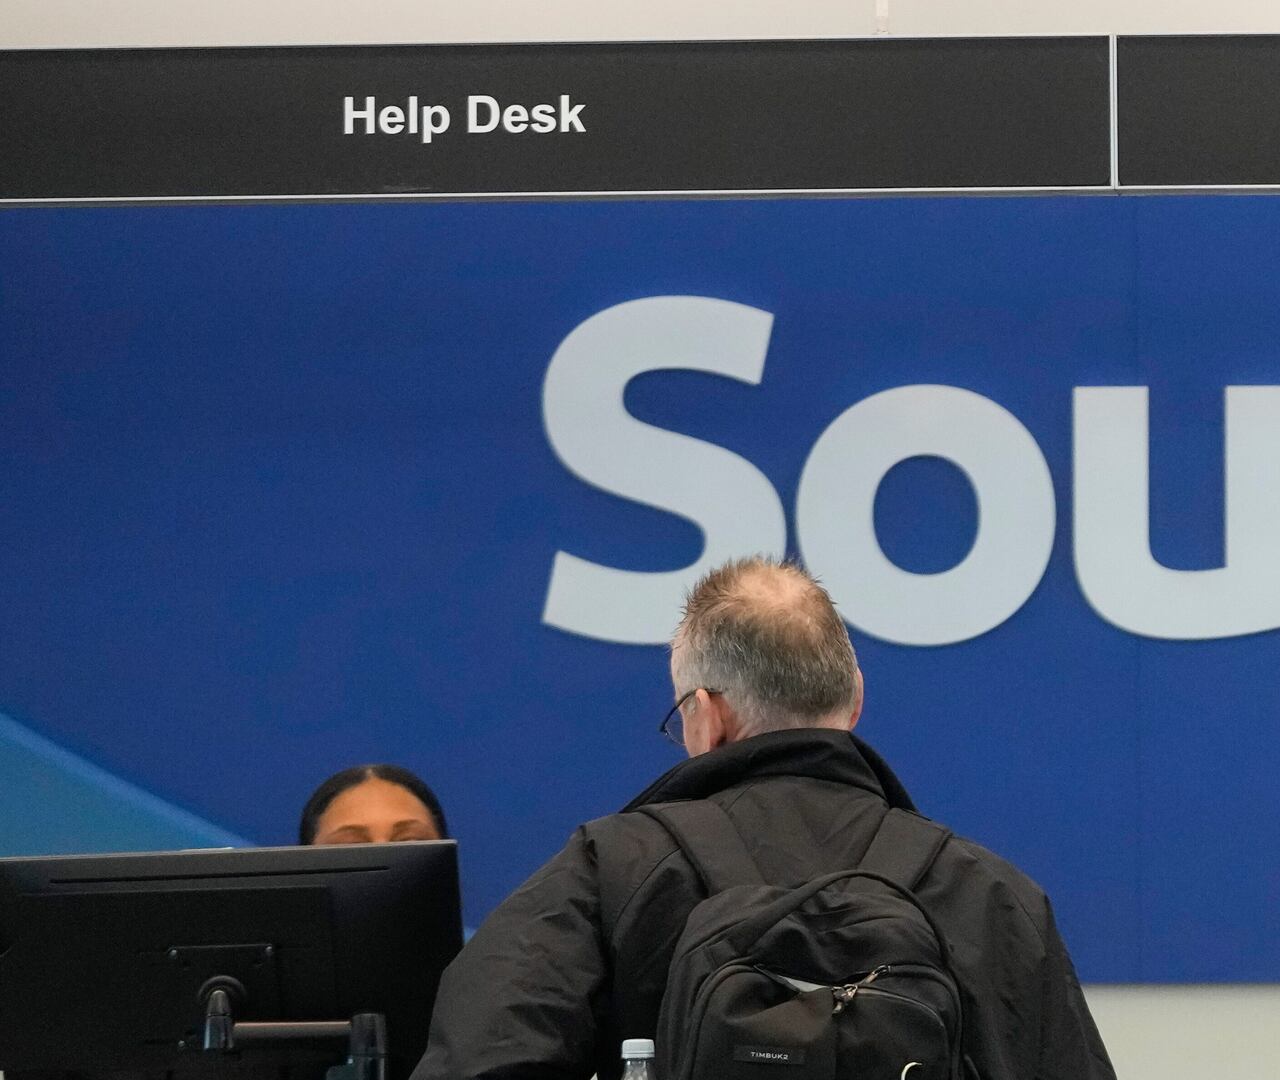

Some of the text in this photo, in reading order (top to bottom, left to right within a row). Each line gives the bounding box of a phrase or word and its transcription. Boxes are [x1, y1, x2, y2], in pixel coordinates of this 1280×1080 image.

[343, 95, 587, 143] Help Desk
[750, 1051, 789, 1060] TIMBUK2
